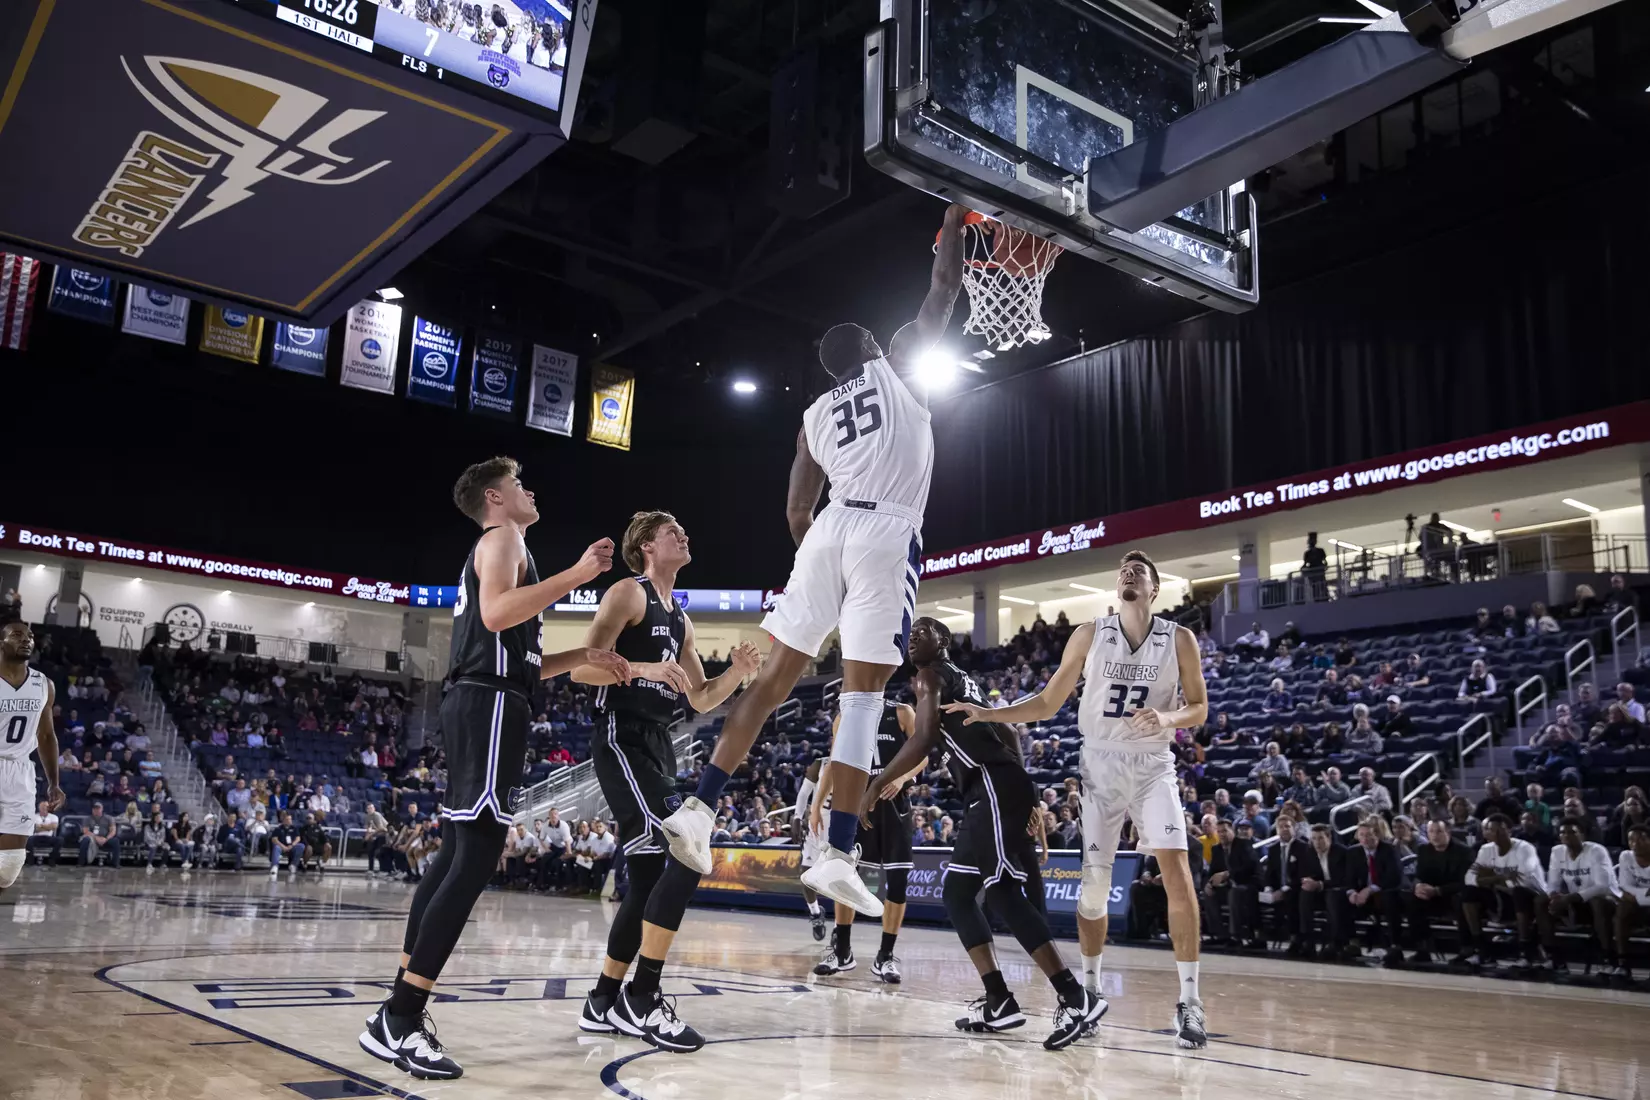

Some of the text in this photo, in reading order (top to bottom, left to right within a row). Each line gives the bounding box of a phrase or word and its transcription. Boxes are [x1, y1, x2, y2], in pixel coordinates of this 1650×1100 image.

[294, 13, 361, 45] 1ST HALF
[423, 28, 439, 57] 7
[402, 55, 443, 80] FLS 1
[72, 131, 221, 258] LANCERS
[131, 313, 181, 329] CHAMPIONS
[153, 310, 185, 323] REGION
[224, 312, 248, 324] NCAA
[208, 325, 248, 340] DIVISION
[424, 321, 452, 337] 2017
[210, 334, 252, 349] NATIONAL
[419, 331, 455, 346] WOMEN'S
[485, 338, 513, 352] 2017
[274, 343, 324, 360] CHAMPIONS
[480, 349, 514, 362] WOMEN'S
[352, 360, 381, 371] DIVISION
[542, 354, 568, 368] 2017
[345, 365, 393, 380] TOURNAMENT
[537, 364, 569, 377] WOMEN'S
[411, 376, 455, 392] CHAMPIONS
[831, 376, 867, 401] DAVIS
[474, 399, 512, 413] CHAMPIONS
[831, 387, 882, 449] 35
[1200, 421, 1610, 519] Book Tee Times at www.goosecreekgc.com
[1037, 521, 1107, 555] Goose Creek
[1052, 539, 1091, 555] GOLF CLUB
[18, 529, 62, 549] Book
[66, 536, 95, 553] Tee
[98, 541, 145, 560] Times
[147, 550, 164, 563] at
[166, 553, 333, 589] www.goosecreekgc.com
[926, 553, 957, 573] Rated
[958, 547, 982, 566] Golf
[984, 538, 1031, 561] Course!
[342, 577, 410, 599] Goose Creek
[357, 591, 395, 603] GOLF CLUB
[569, 589, 597, 604] 16:26
[99, 606, 145, 618] EQUIPPED
[99, 614, 143, 626] TO SERVE
[210, 620, 254, 632] GLOBALLY
[1103, 661, 1158, 681] LANCERS
[1103, 684, 1150, 719] 33
[6, 715, 28, 744] 0
[905, 885, 932, 897] GOLF
